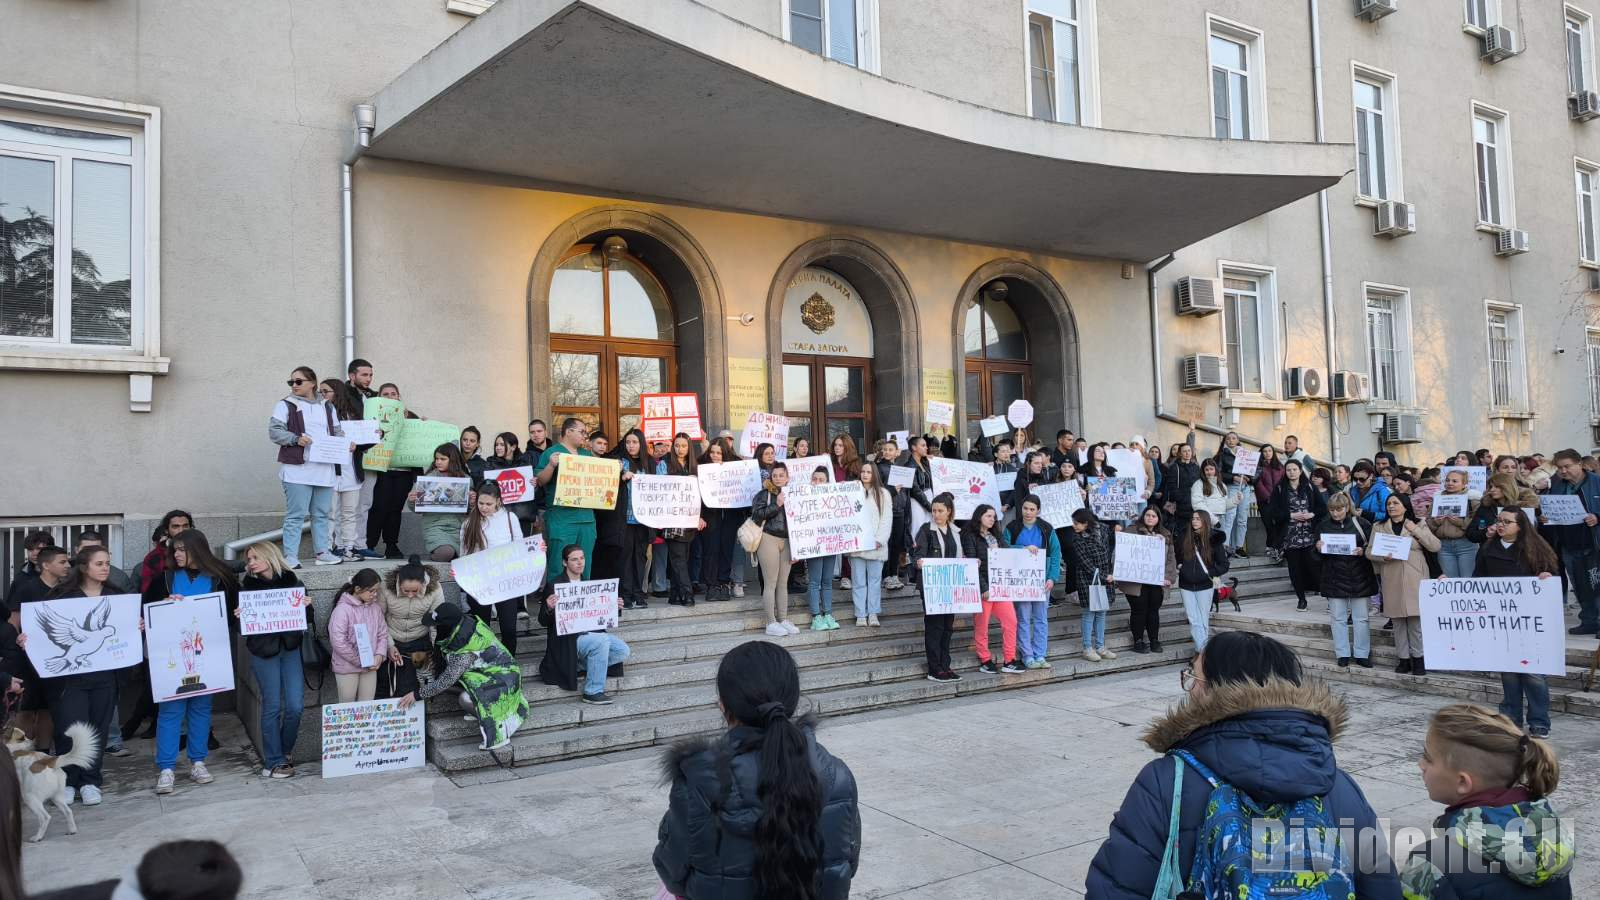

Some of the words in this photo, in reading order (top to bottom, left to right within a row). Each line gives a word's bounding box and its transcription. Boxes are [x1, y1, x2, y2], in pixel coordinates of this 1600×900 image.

[819, 273, 851, 300] ПАЛАТА
[788, 342, 815, 351] СТАРА
[817, 343, 848, 353] ЗАГОРА
[638, 482, 647, 491] ТЕ
[649, 482, 658, 491] НЕ
[788, 484, 809, 498] ДНЕС
[798, 499, 818, 514] УТРЕ
[821, 494, 851, 510] ХОРА
[833, 506, 856, 520] СЕГА
[990, 567, 1003, 577] ТЕ
[265, 591, 287, 599] МОГАТ
[556, 587, 568, 598] ТЕ
[569, 586, 578, 596] НЕ
[1429, 580, 1522, 597] ЗООПОЛИЦИЯ
[1532, 580, 1542, 595] В
[1450, 599, 1487, 612] ПОЛЗА
[1500, 599, 1518, 613] НА
[1438, 615, 1545, 633] ЖИВОТНИТЕ
